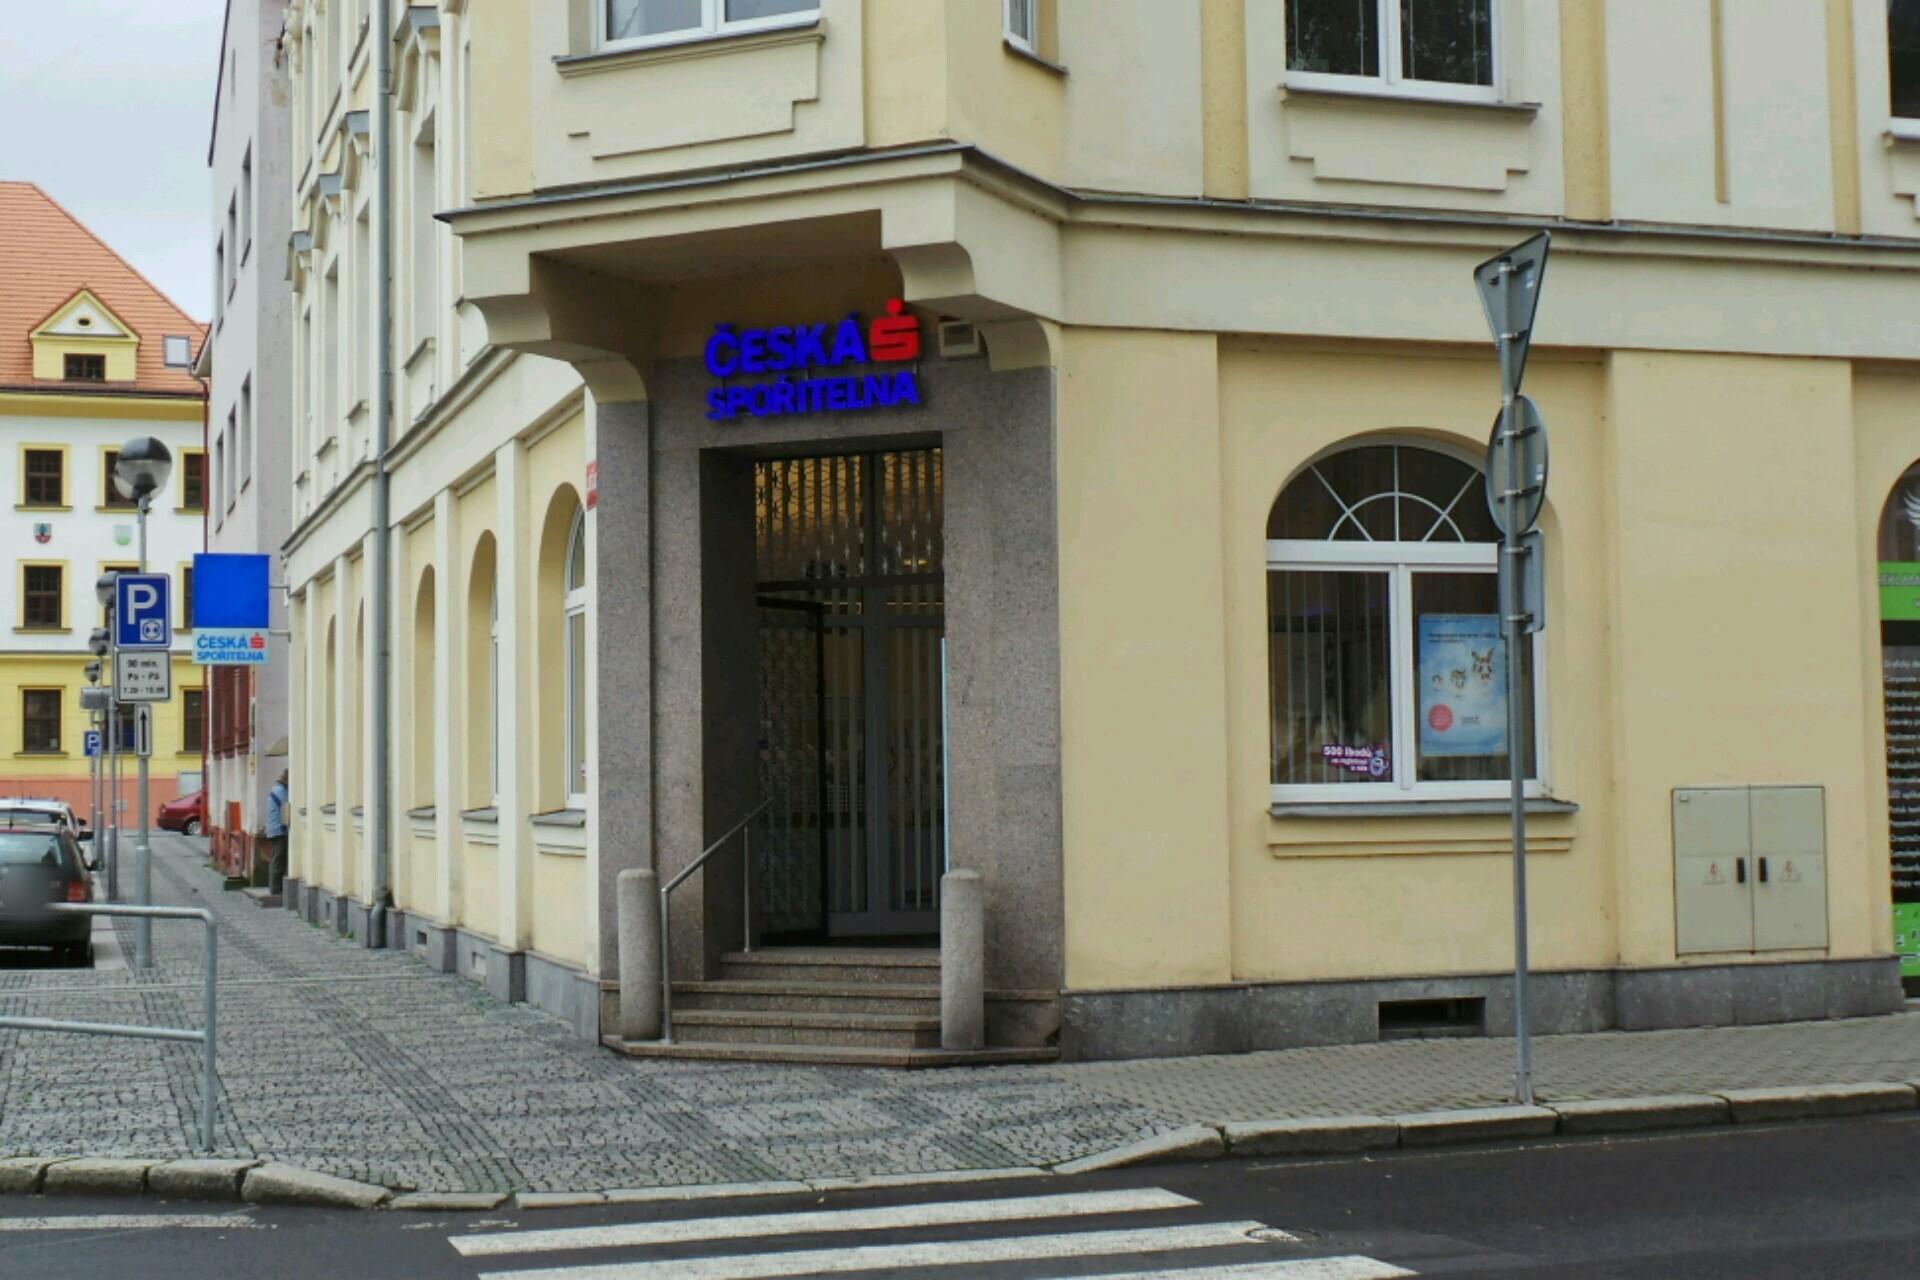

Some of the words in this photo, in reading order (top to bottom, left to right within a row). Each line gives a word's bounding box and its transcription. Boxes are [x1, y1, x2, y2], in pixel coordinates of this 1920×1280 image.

[704, 311, 869, 377] ČESKÁ
[704, 370, 920, 422] SPOŘITELNA
[127, 584, 158, 625] P
[197, 633, 248, 649] ČESKÁ
[197, 649, 265, 661] SPOŘITELNA
